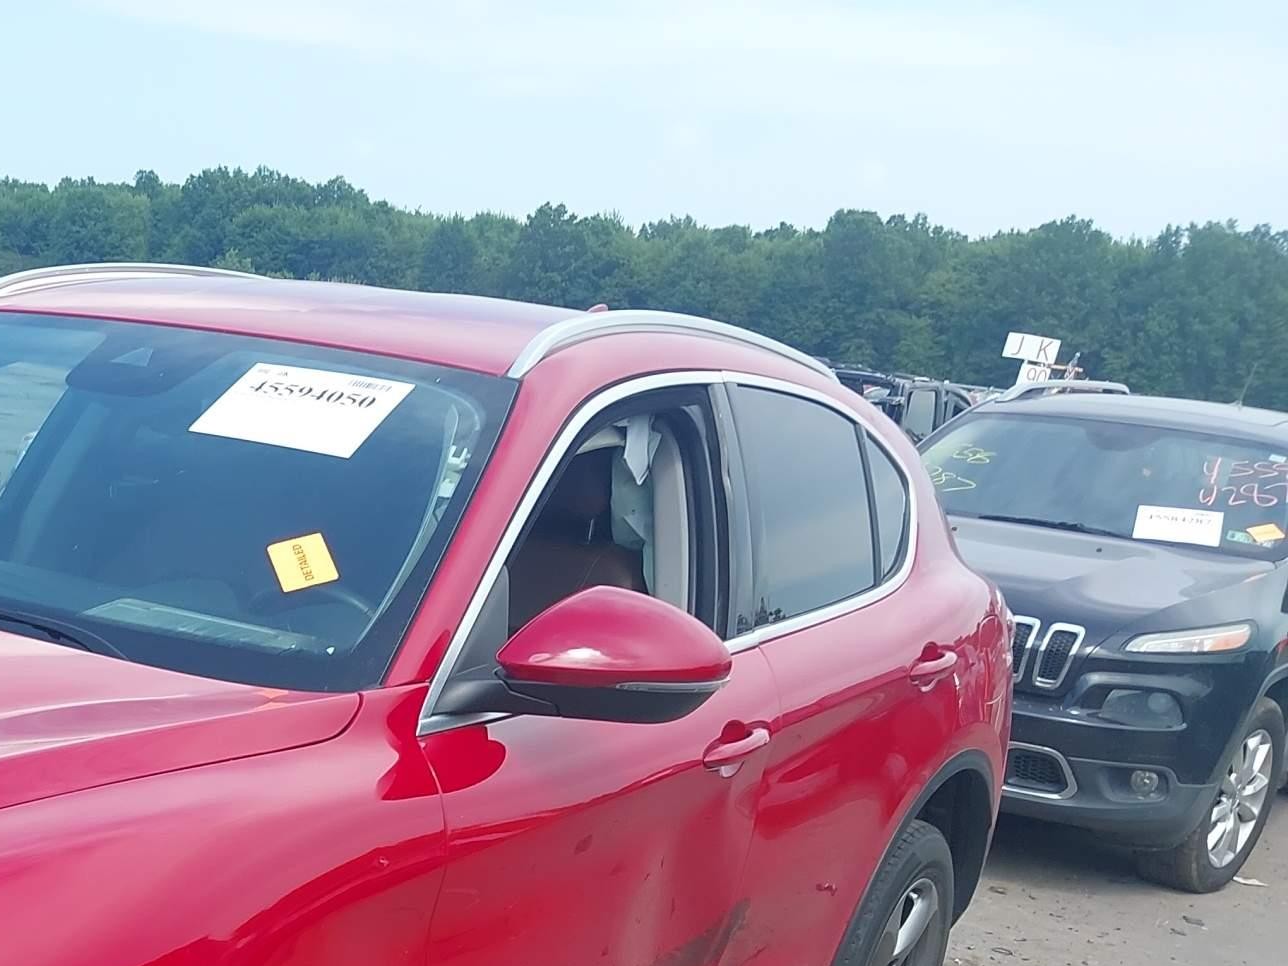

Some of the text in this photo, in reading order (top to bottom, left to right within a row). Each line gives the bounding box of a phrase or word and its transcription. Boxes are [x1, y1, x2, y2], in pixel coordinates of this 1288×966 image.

[1010, 335, 1054, 362] J K
[249, 380, 377, 409] 45594050
[291, 543, 315, 582] DETAILED
